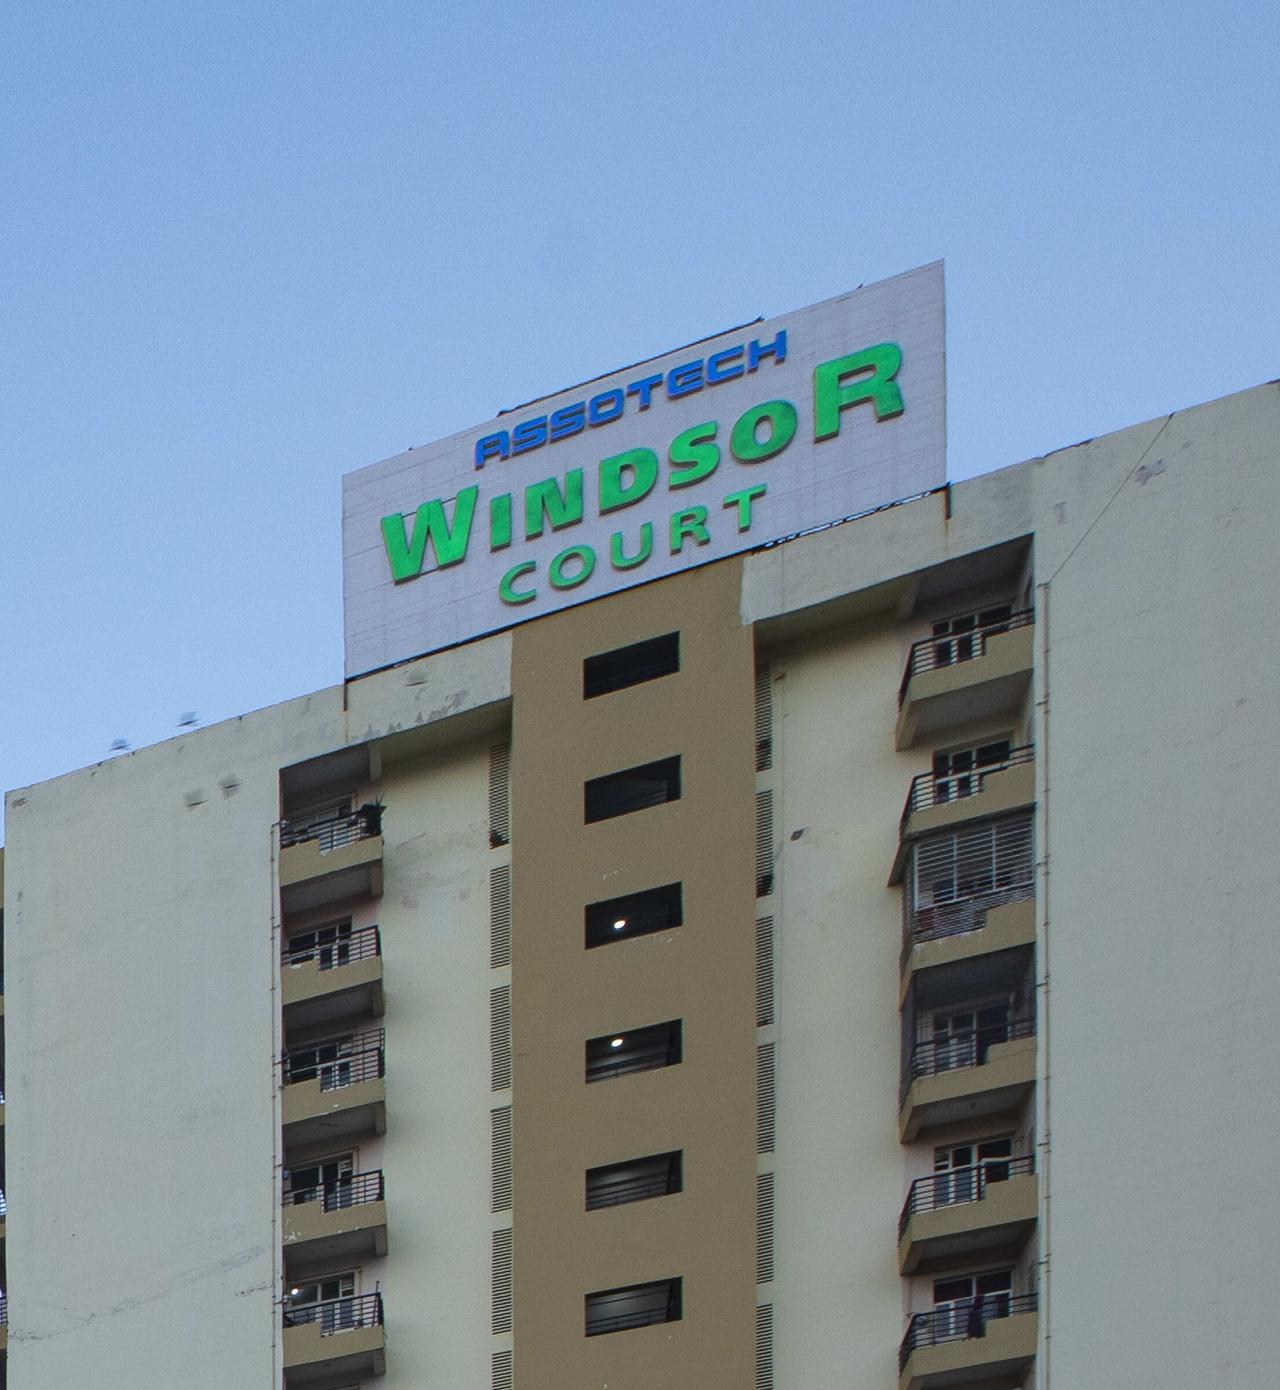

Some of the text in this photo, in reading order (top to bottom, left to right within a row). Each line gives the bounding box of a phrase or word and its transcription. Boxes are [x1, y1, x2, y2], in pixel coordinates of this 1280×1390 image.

[380, 341, 905, 585] WINDSOR
[474, 329, 789, 470] ASSOTECH
[498, 484, 767, 604] COURT
